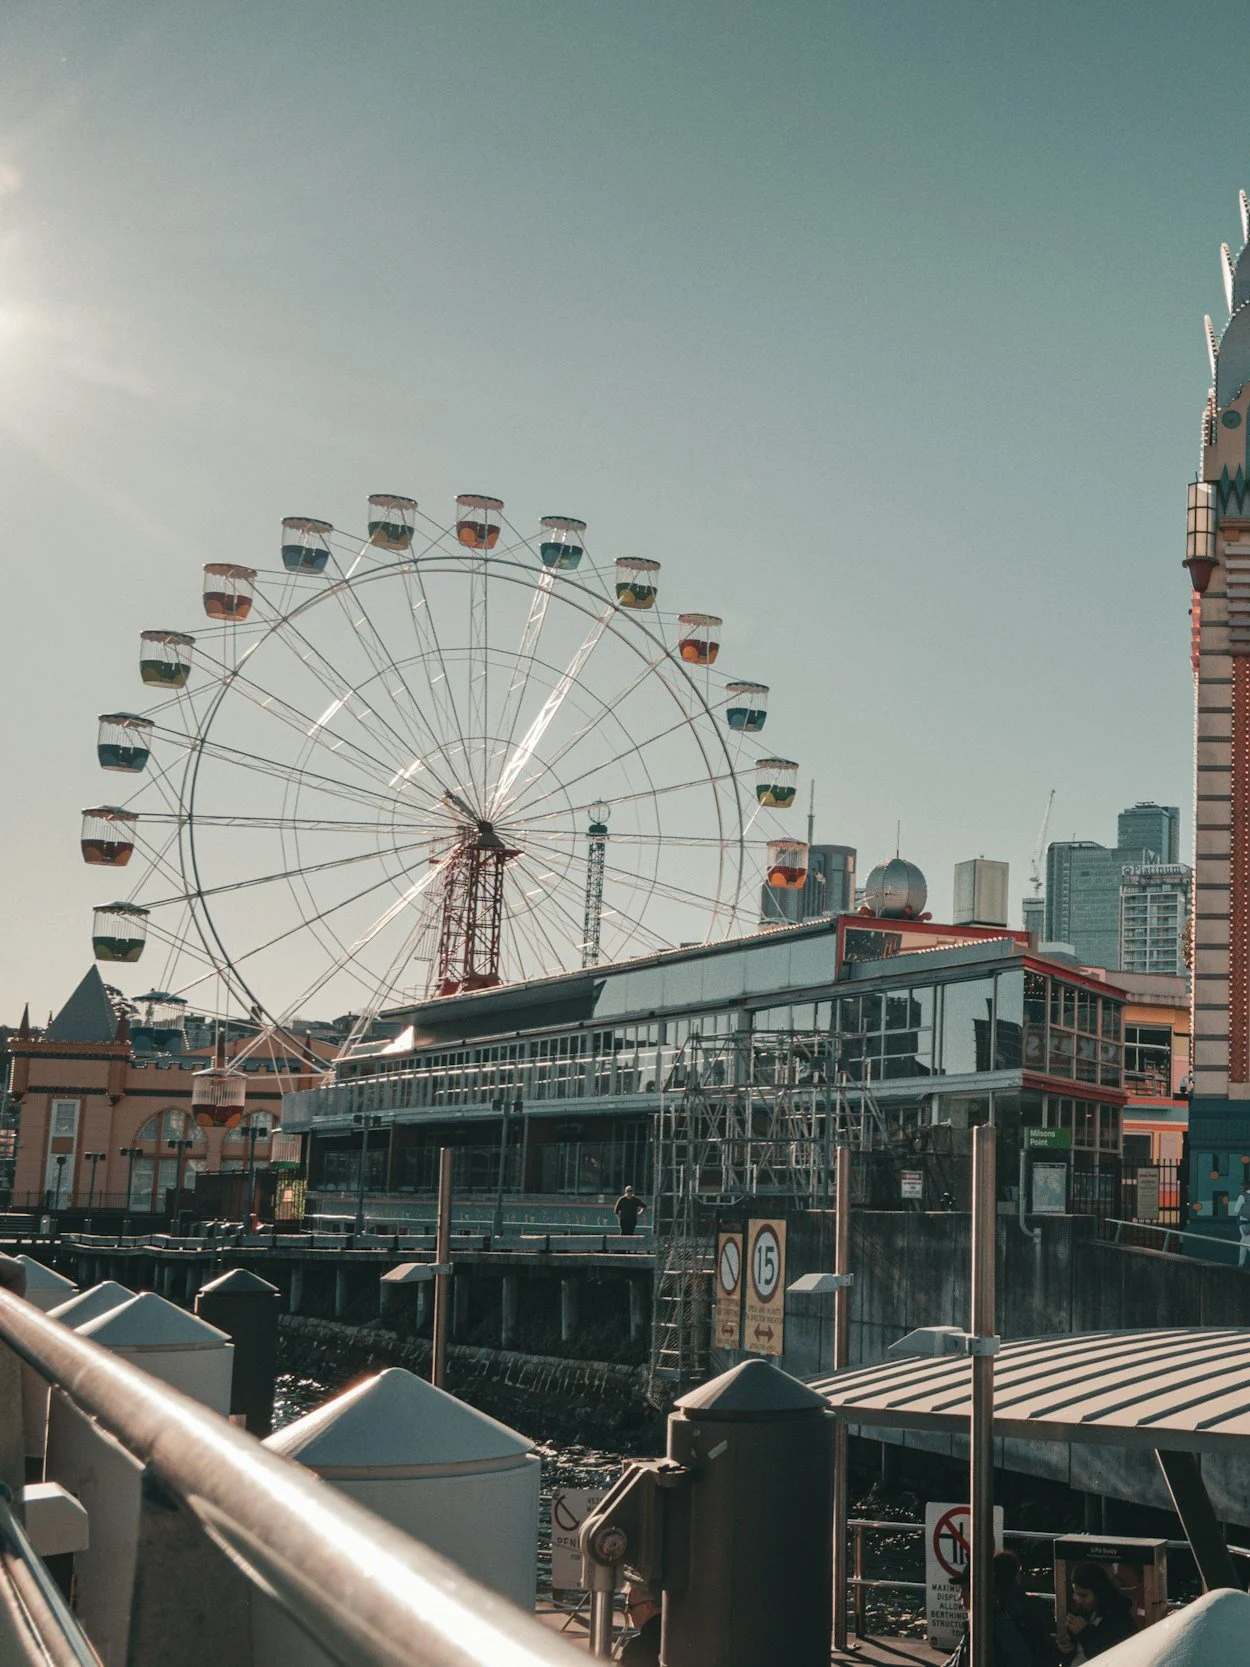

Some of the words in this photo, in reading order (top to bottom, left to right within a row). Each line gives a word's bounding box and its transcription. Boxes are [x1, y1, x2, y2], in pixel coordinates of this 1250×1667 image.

[1030, 1129, 1056, 1138] Milsons
[1030, 1138, 1048, 1146] Point
[757, 1245, 775, 1286] 15
[931, 1583, 961, 1593] MAXIMU
[931, 1619, 963, 1629] STRUCTU
